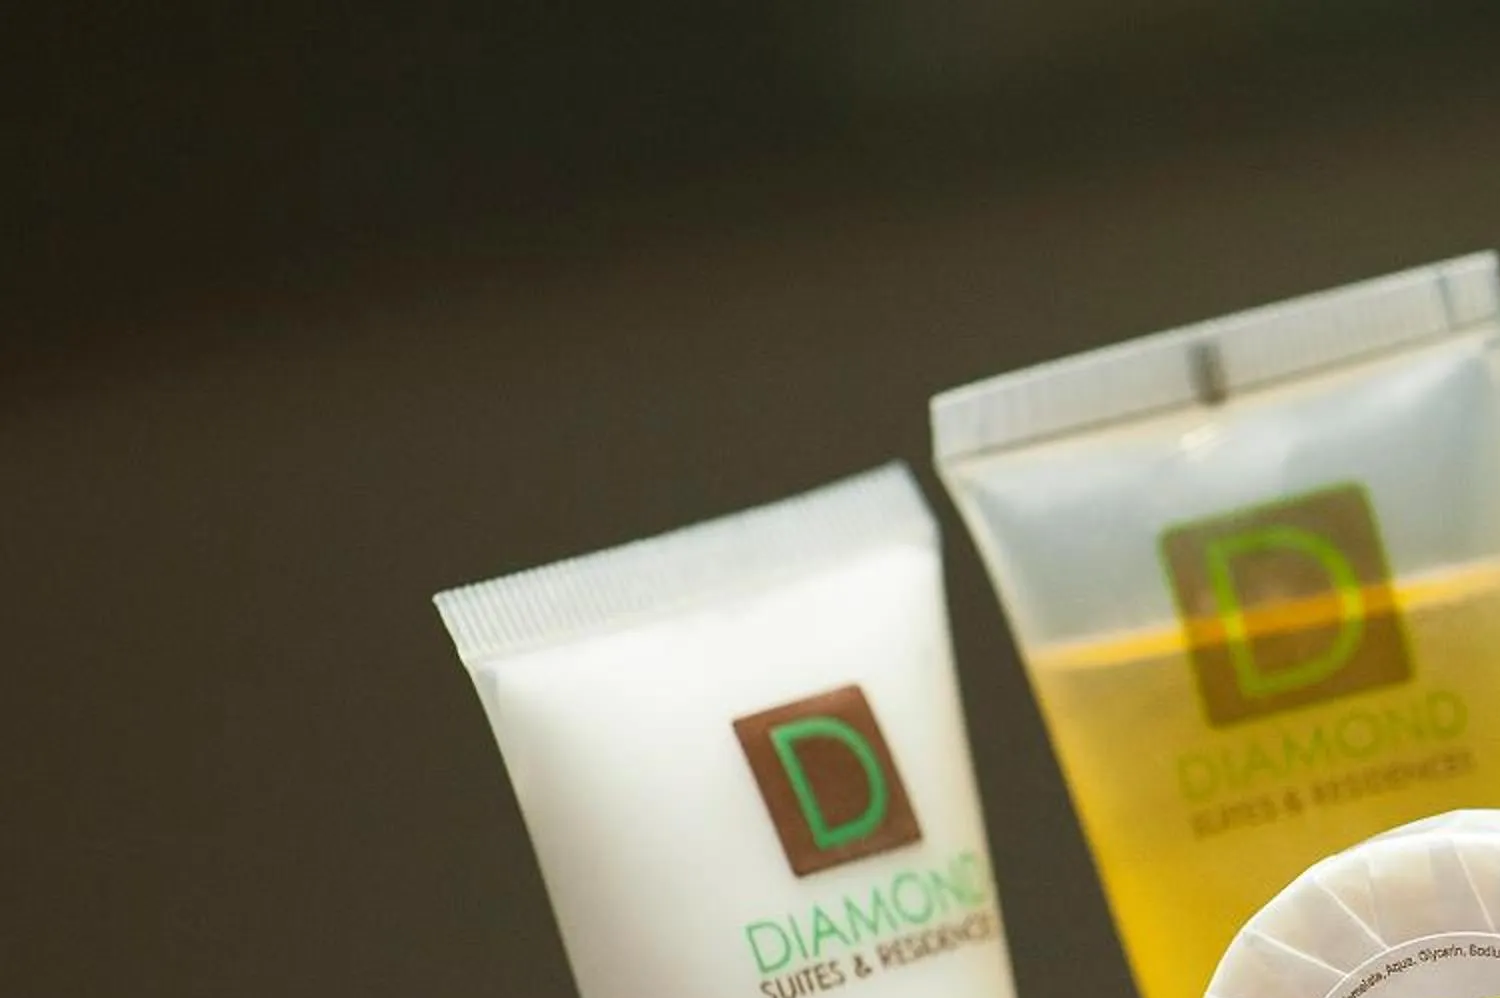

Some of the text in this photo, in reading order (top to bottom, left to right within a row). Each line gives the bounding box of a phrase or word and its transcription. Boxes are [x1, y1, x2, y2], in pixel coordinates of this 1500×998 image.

[1207, 525, 1366, 697] D
[769, 716, 889, 850] D
[1176, 690, 1469, 800] DIAMOND
[854, 955, 873, 978] &
